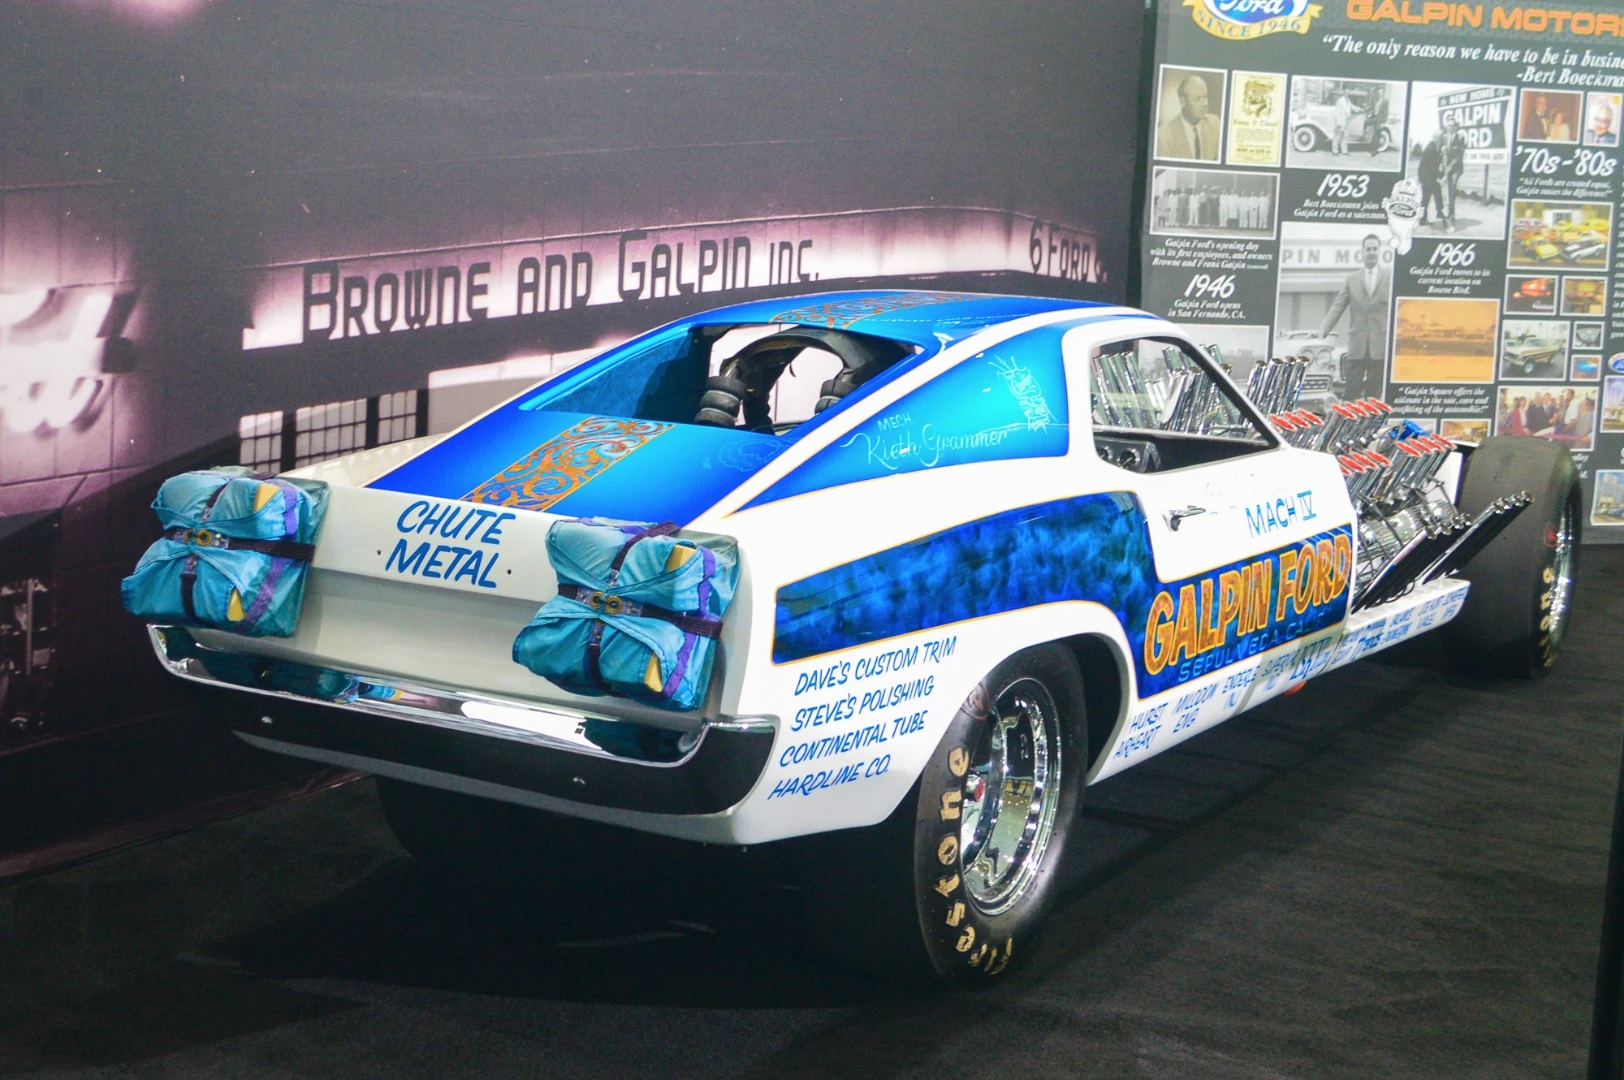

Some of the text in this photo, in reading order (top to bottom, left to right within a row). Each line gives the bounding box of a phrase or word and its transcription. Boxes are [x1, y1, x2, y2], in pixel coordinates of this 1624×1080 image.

[1197, 9, 1302, 38] SINCE 1946
[1346, 0, 1624, 38] GALPIN MOTOR
[1366, 38, 1401, 60] only
[1404, 42, 1456, 59] reason
[1460, 46, 1481, 61] we
[1484, 43, 1519, 63] have
[1522, 46, 1538, 64] to
[1541, 46, 1560, 65] be
[1562, 48, 1578, 66] in
[1516, 66, 1555, 84] -Bert
[1442, 102, 1501, 127] GALPIN
[1457, 127, 1493, 148] ORD
[1316, 173, 1370, 198] 1953
[1294, 208, 1319, 219] Galpin
[1319, 208, 1340, 218] Ford
[1150, 247, 1166, 257] with
[1166, 248, 1176, 257] its
[1175, 248, 1193, 259] first
[1231, 250, 1247, 260] and
[1165, 238, 1191, 250] Galpin
[1215, 240, 1245, 252] opening
[1245, 241, 1260, 252] day
[1282, 248, 1320, 264] PIN
[1428, 242, 1477, 267] 1966
[1152, 257, 1181, 267] Browne
[1181, 258, 1197, 267] and
[1220, 258, 1246, 270] Galpin
[1409, 266, 1435, 276] Galpin
[1434, 266, 1453, 276] Ford
[302, 260, 492, 342] BROWNE
[618, 230, 752, 304] GALPIN
[1184, 273, 1237, 299] 1946
[1168, 308, 1177, 317] in
[1177, 308, 1192, 318] San
[1231, 309, 1247, 319] CA.
[1174, 298, 1242, 311] Galpin Ford opens
[396, 500, 517, 545] CHUTE
[1245, 490, 1317, 538] MACH IV
[385, 538, 499, 589] METAL
[1144, 559, 1272, 675] GALPIN
[1275, 533, 1353, 622] FORD
[794, 635, 958, 697] DAVE'S CUSTOM TRIM
[1177, 627, 1280, 682] SEPULVEDA
[790, 674, 935, 733] STEVE'S POLISHING
[779, 709, 929, 768] CONTINENTAL TUBE
[767, 761, 864, 801] HARDLINE
[932, 745, 1013, 976] Firestone
